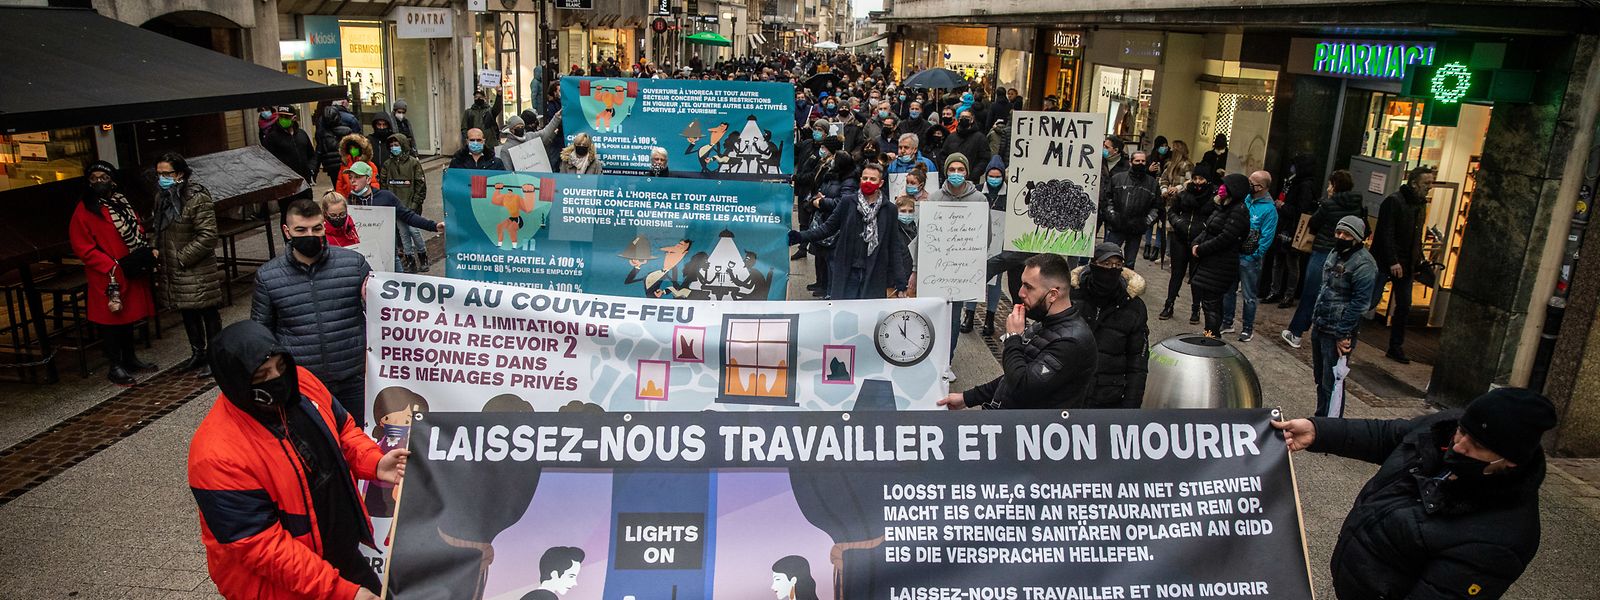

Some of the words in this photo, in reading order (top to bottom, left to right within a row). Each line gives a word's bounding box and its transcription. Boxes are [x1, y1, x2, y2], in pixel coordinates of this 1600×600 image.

[680, 87, 684, 95] À
[567, 135, 601, 143] CHGE
[632, 135, 638, 144] À
[632, 153, 637, 161] À
[562, 188, 614, 198] OUVERTURE
[617, 187, 623, 198] À
[626, 190, 668, 200] L'HORECA
[671, 193, 682, 201] ET
[684, 193, 706, 202] TOUT
[710, 195, 738, 204] AUTRE
[562, 198, 602, 208] SECTEUR
[604, 198, 651, 209] CONCERNÉ
[654, 202, 672, 210] PAR
[693, 203, 756, 214] RESTRICTIONS
[562, 216, 611, 225] SPORTIVES
[629, 219, 673, 228] TOURISME
[576, 208, 614, 216] VIGUEUR
[637, 210, 680, 220] QU'ENTRE
[682, 213, 710, 221] AUTRE
[713, 214, 730, 222] LES
[732, 214, 781, 224] ACTIVITÉS
[456, 252, 504, 263] CHOMAGE
[507, 256, 546, 266] PARTIEL
[549, 254, 556, 266] À
[558, 257, 574, 268] 100
[576, 258, 584, 268] %
[494, 264, 504, 272] 80
[505, 265, 512, 273] %
[546, 268, 582, 276] EMPLOYÉS
[556, 283, 572, 292] 100
[380, 280, 454, 305] STOP
[464, 289, 503, 308] AU
[511, 292, 694, 324] COUVRE-FEU
[380, 307, 429, 323] STOP
[434, 306, 448, 326] À
[454, 314, 476, 328] LA
[483, 316, 579, 336] LIMITATION
[585, 324, 609, 338] DE
[381, 326, 460, 345] POUVOIR
[467, 333, 558, 352] RECEVOIR
[564, 336, 578, 358] 2
[381, 347, 489, 366] PERSONNES
[496, 354, 547, 370] DANS
[379, 364, 410, 380] LES
[416, 362, 504, 386] MÉNAGES
[510, 370, 578, 391] PRIVÉS
[428, 424, 706, 462] LAISSEZ-NOUS
[719, 424, 944, 462] TRAVAILLER
[958, 424, 1002, 461] ET
[1016, 423, 1097, 461] NON
[1110, 422, 1260, 460] MOURIR
[883, 484, 946, 500] LOOSST
[951, 484, 976, 499] EIS
[1030, 483, 1112, 500] SCHAFFEN
[1118, 483, 1140, 498] AN
[1144, 482, 1173, 498] NET
[1179, 476, 1262, 497] STIERWEN
[884, 506, 939, 520] MACHT
[944, 506, 969, 520] EIS
[974, 498, 1036, 520] CAFÉEN
[1040, 505, 1062, 520] AN
[1068, 503, 1192, 520] RESTAURANTEN
[1198, 502, 1233, 515] REM
[1238, 498, 1263, 514] OP.
[625, 526, 698, 542] LIGHTS
[884, 526, 938, 541] ENNER
[944, 526, 1026, 541] STRENGEN
[1032, 520, 1121, 541] SANITÄREN
[1126, 523, 1202, 540] OPLAGEN
[1208, 522, 1230, 536] AN
[1235, 519, 1273, 536] GIDD
[643, 548, 674, 563] ON
[886, 547, 911, 562] EIS
[916, 547, 941, 562] DIE
[947, 547, 1065, 564] VERSPRACHEN
[1070, 546, 1154, 562] HELLEFEN.
[890, 587, 1018, 600] LAISSEZ-NOUS
[1023, 586, 1124, 600] TRAVAILLER
[1130, 586, 1150, 598] ET
[1157, 584, 1194, 598] NON
[1200, 582, 1268, 597] MOURIR
